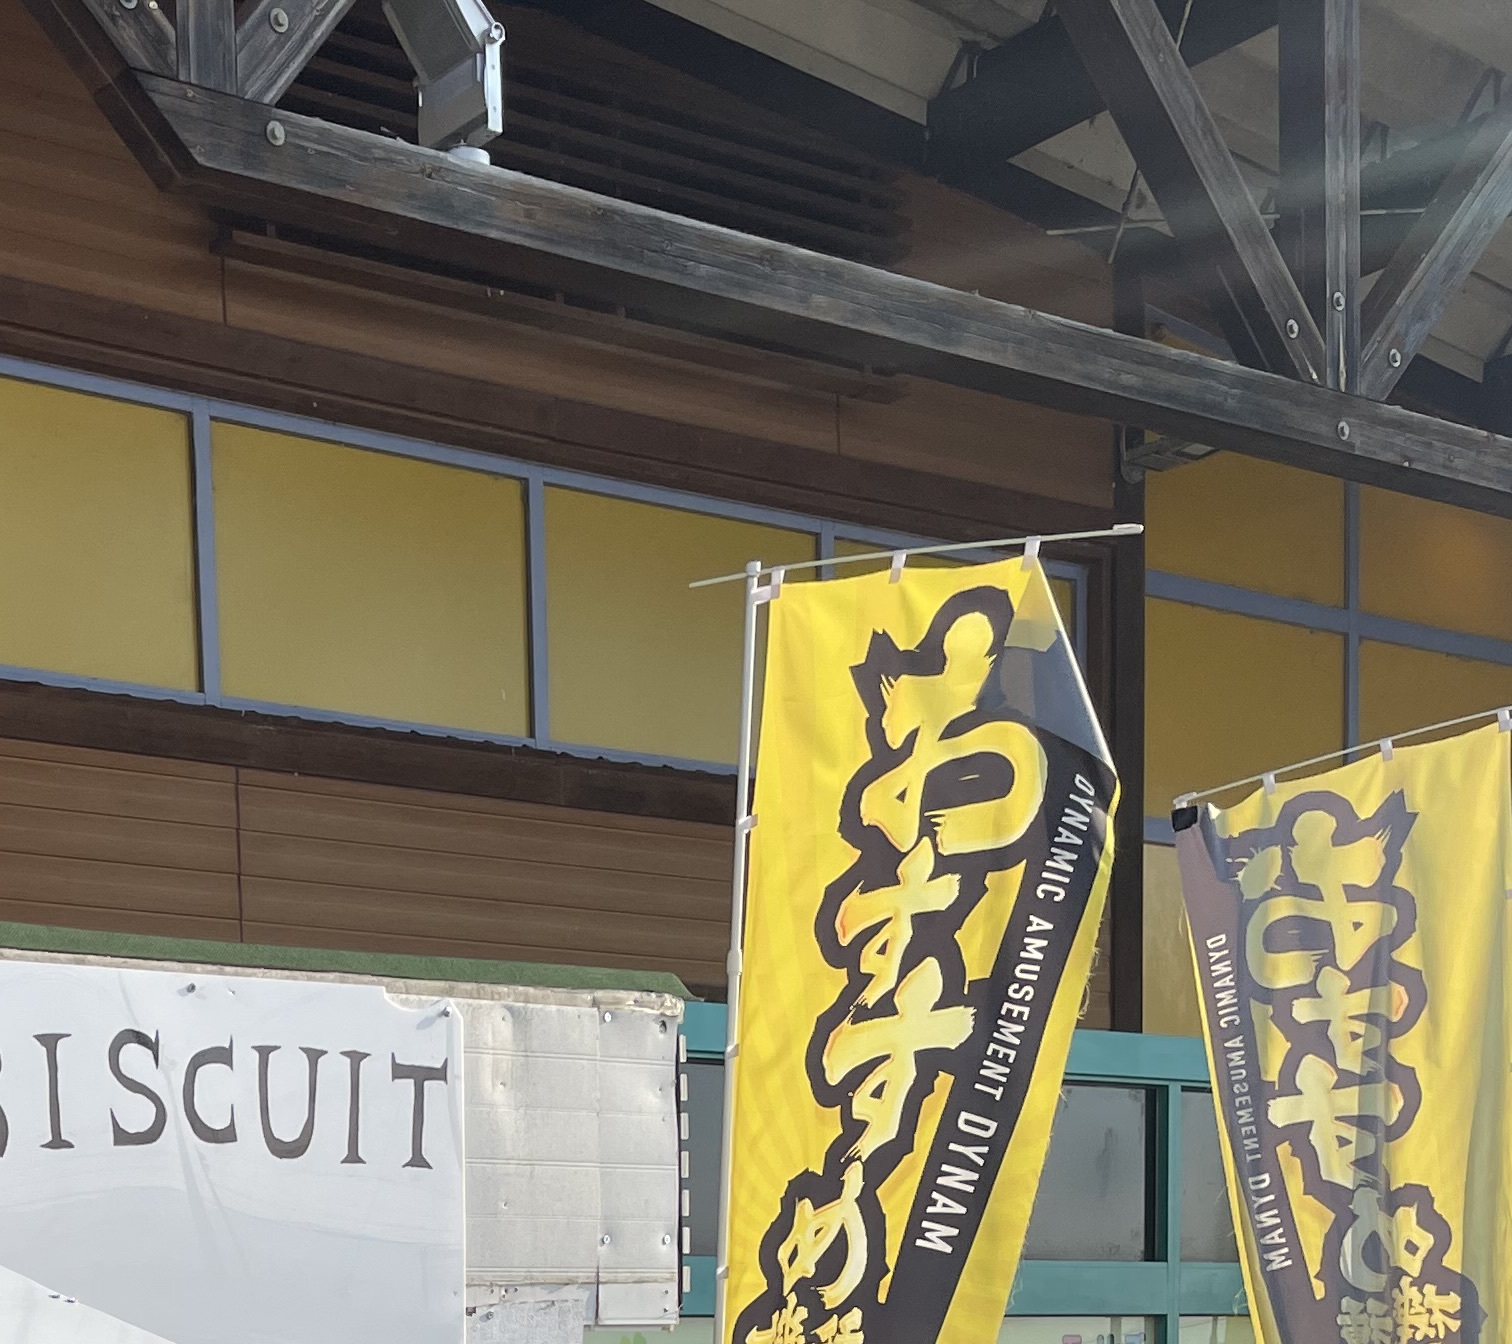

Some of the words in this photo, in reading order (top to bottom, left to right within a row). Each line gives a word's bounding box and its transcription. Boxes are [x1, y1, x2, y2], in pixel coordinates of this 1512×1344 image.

[1035, 773, 1096, 903] DYNAMIC
[778, 611, 1049, 1308] おすすめ
[973, 912, 1055, 1101] AMUSEMENT
[915, 1109, 999, 1254] DYNAM
